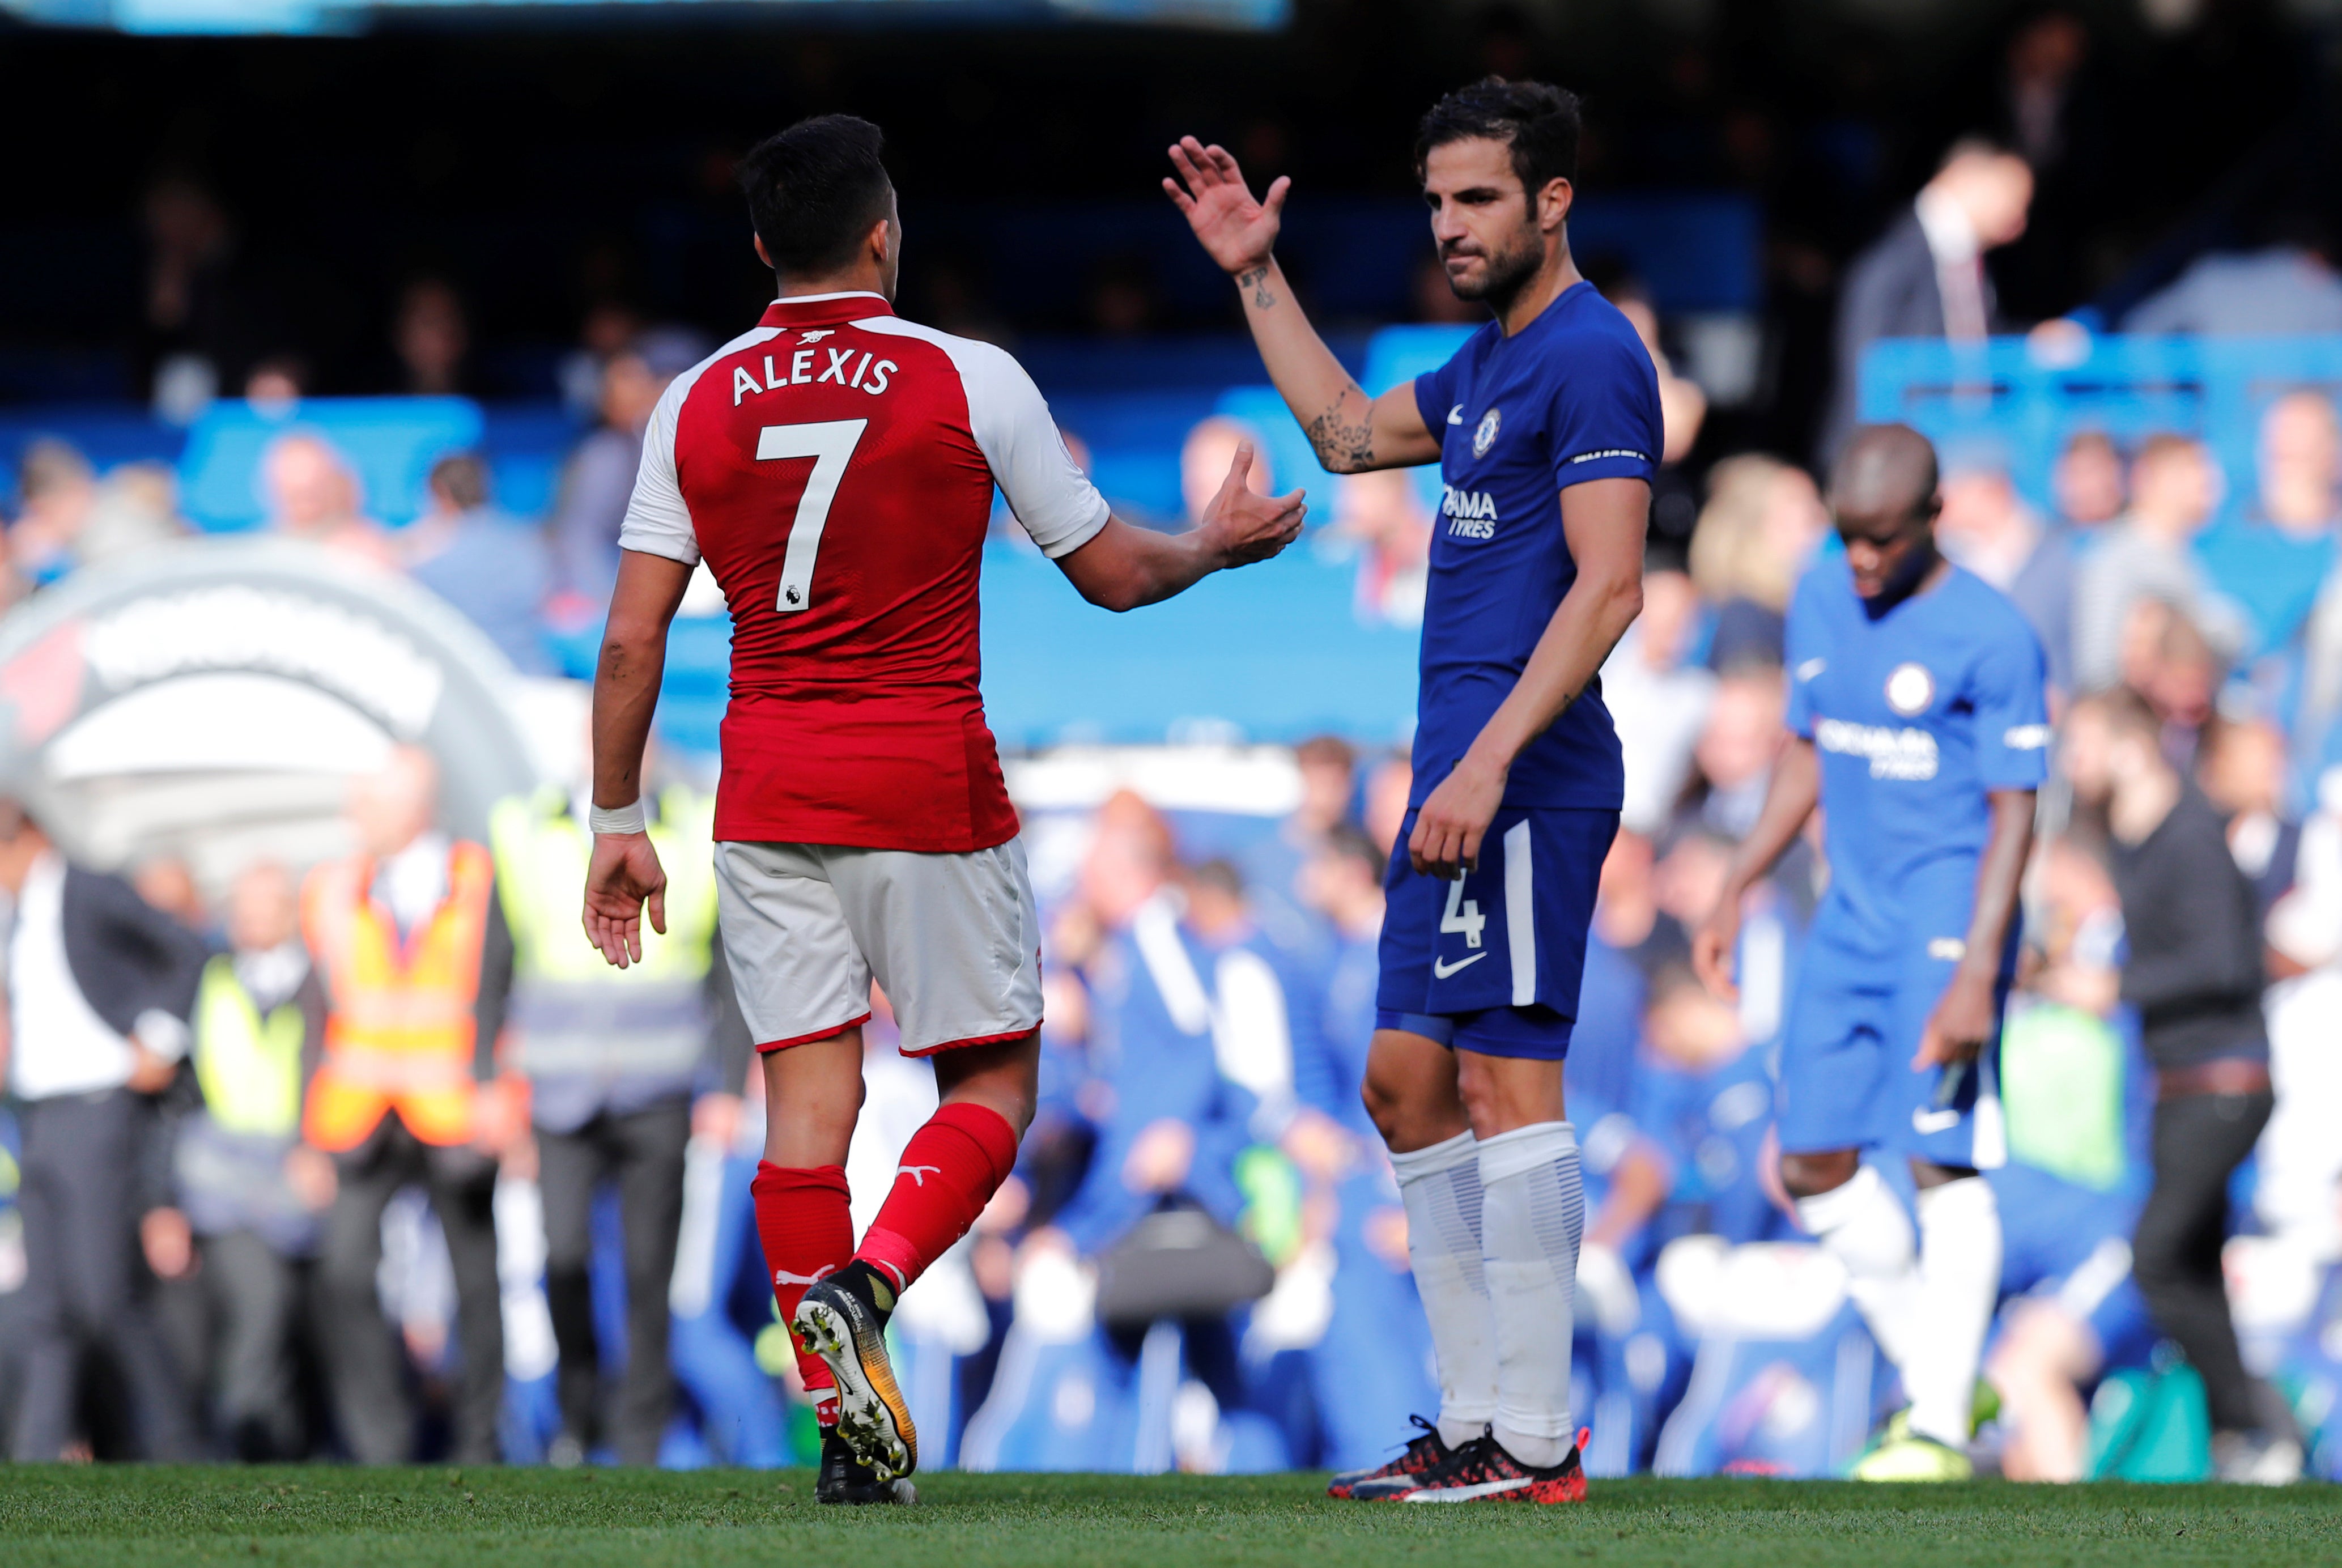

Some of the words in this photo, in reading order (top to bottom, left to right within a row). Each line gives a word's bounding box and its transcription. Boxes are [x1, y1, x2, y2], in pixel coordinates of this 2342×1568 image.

[733, 347, 899, 407] ALEXIS
[755, 418, 869, 612] 7
[1439, 867, 1486, 949] 4
